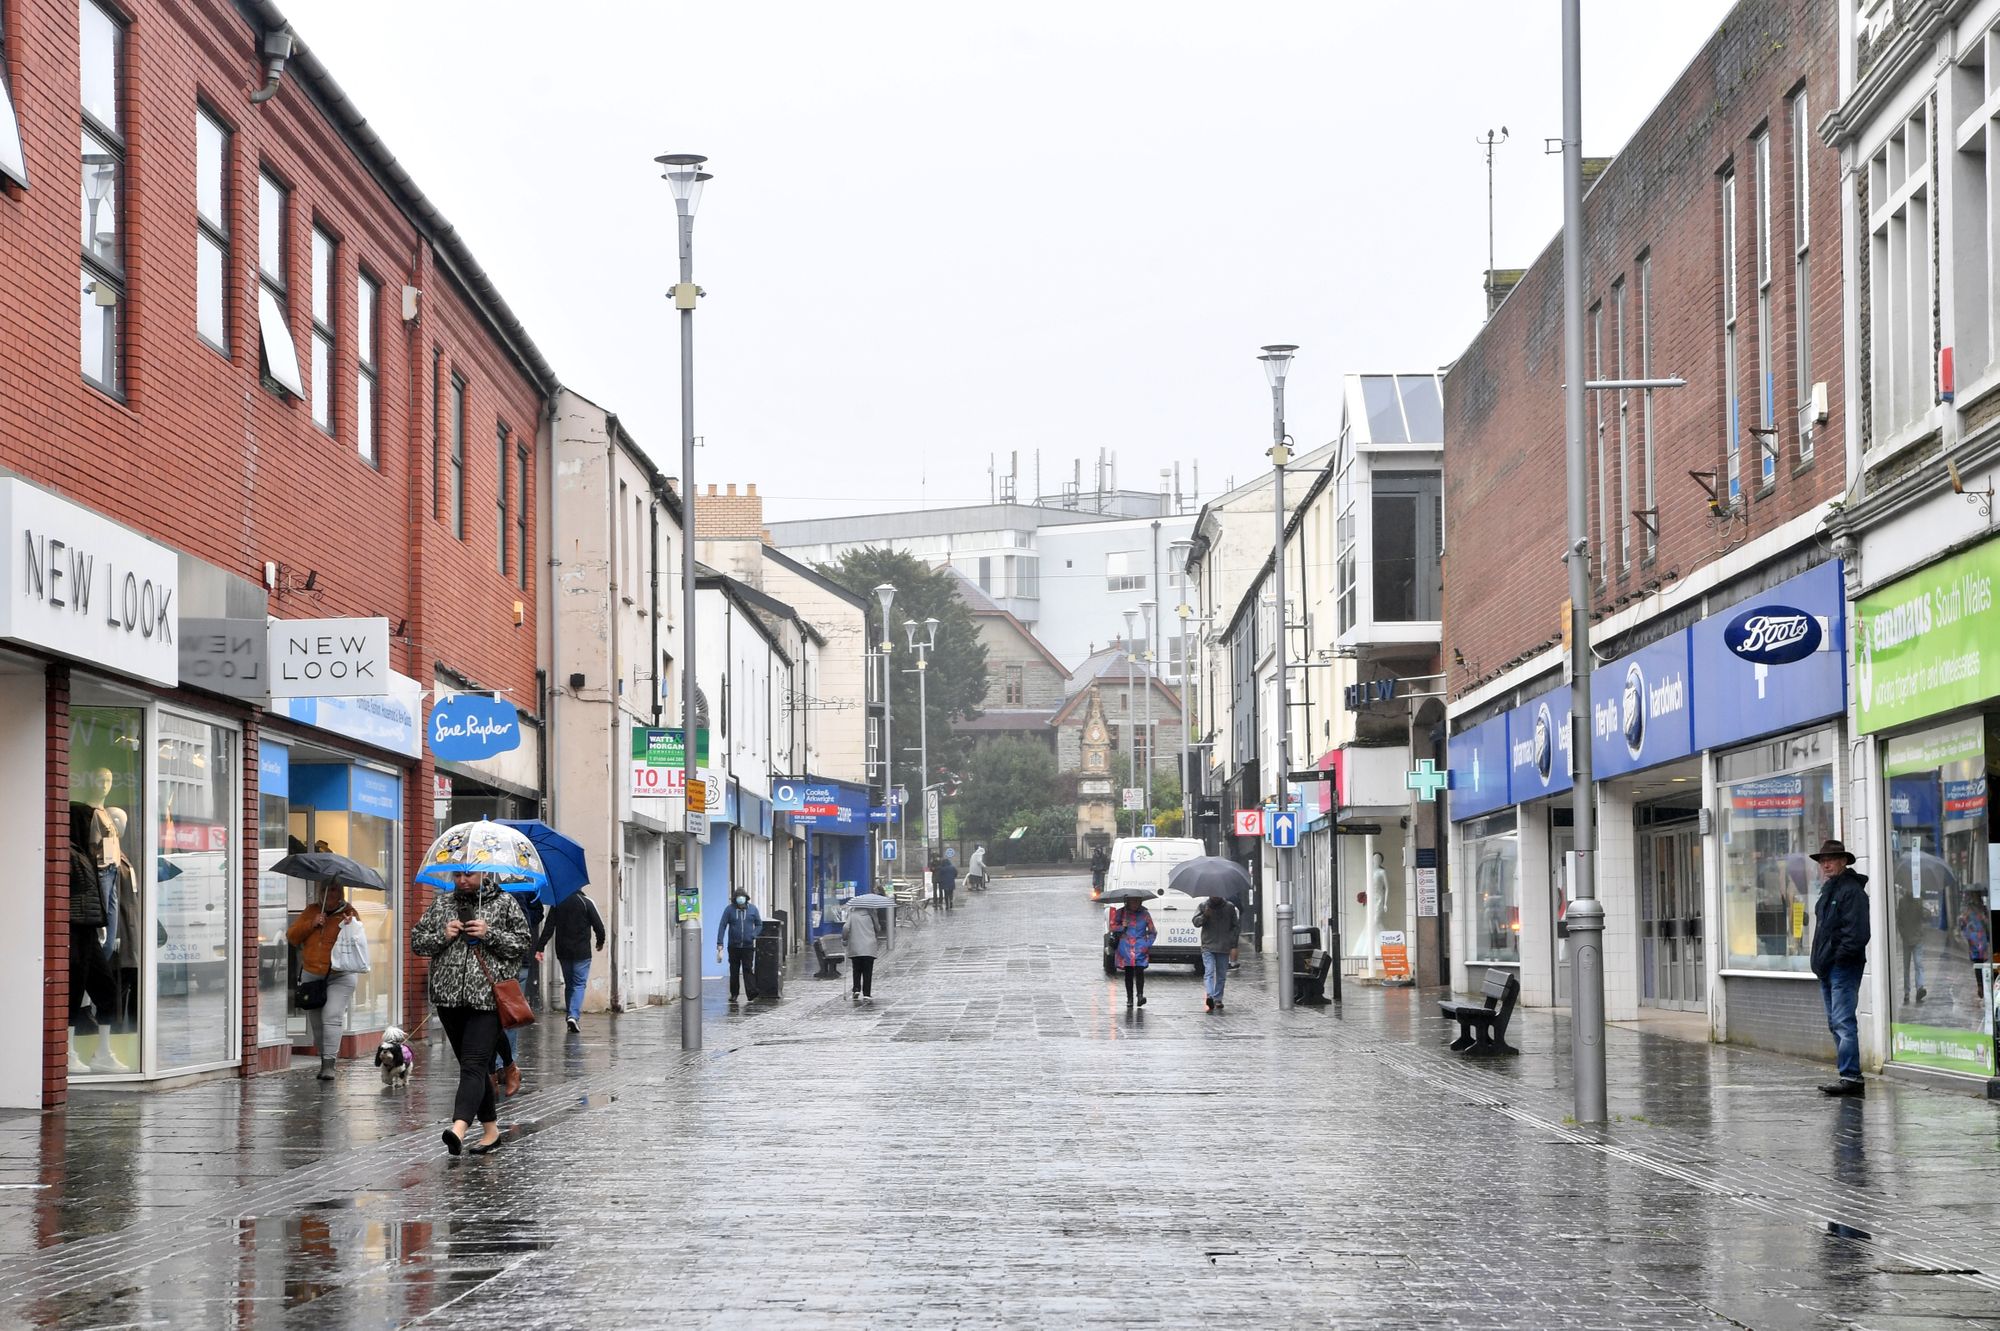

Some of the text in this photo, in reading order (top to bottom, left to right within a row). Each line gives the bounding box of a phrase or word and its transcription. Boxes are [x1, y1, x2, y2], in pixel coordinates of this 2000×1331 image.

[25, 529, 173, 646] NEW LOOK
[1874, 568, 1991, 652] emmaus South Wales
[290, 636, 366, 655] NEW
[1737, 615, 1808, 652] Boots
[283, 660, 374, 680] LOOK
[1649, 672, 1683, 720] harddwch
[435, 713, 466, 742] Sue
[466, 715, 513, 744] Ryder
[1513, 737, 1534, 773] pharmacy
[634, 769, 686, 788] TO LE
[634, 787, 651, 795] PRIME
[806, 795, 834, 803] Arkwright
[1168, 936, 1198, 944] 588600
